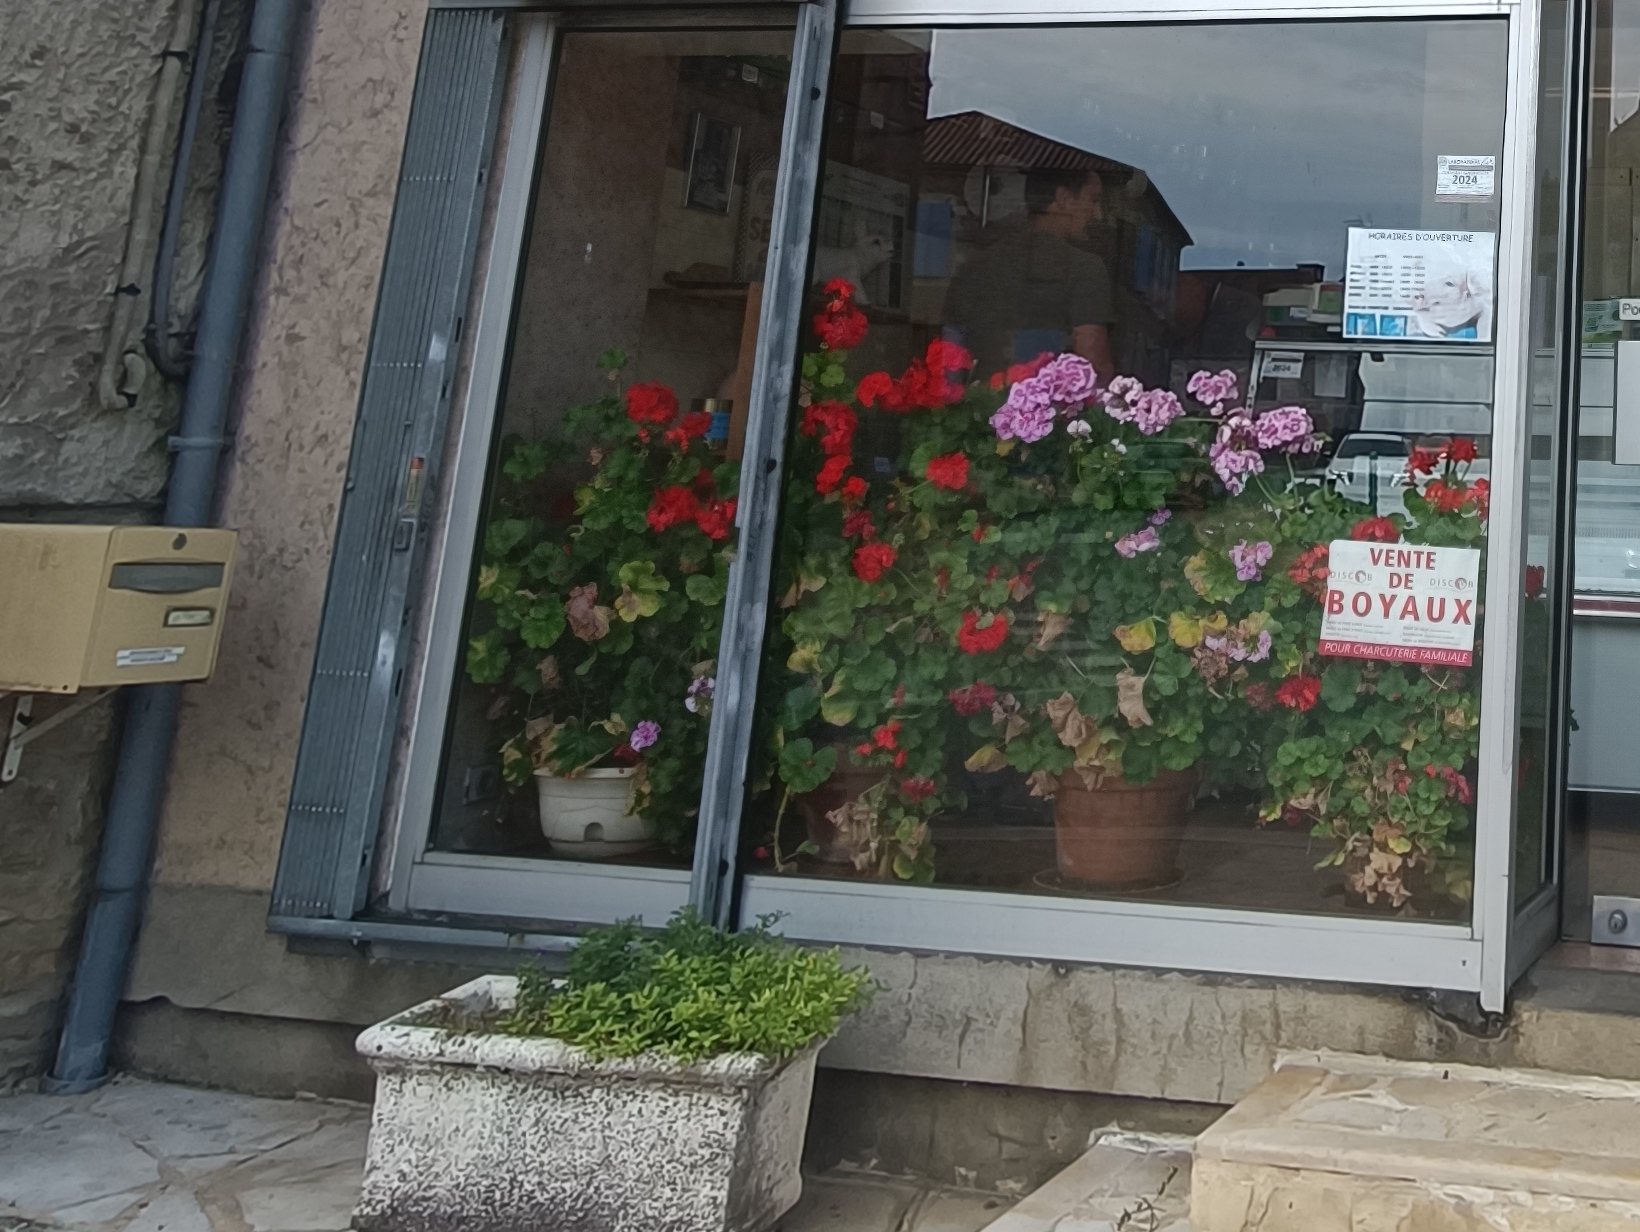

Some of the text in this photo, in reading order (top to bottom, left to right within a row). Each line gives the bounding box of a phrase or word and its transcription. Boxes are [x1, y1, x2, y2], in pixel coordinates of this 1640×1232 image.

[1452, 175, 1478, 185] 2024
[1368, 232, 1474, 243] HORAIRES D'OUVERTURE
[1369, 547, 1437, 571] VENTE
[1388, 572, 1415, 590] DE
[1327, 589, 1473, 626] BOYAUX
[1324, 642, 1468, 664] POUR CHARCUTERIE FAMILIALE
